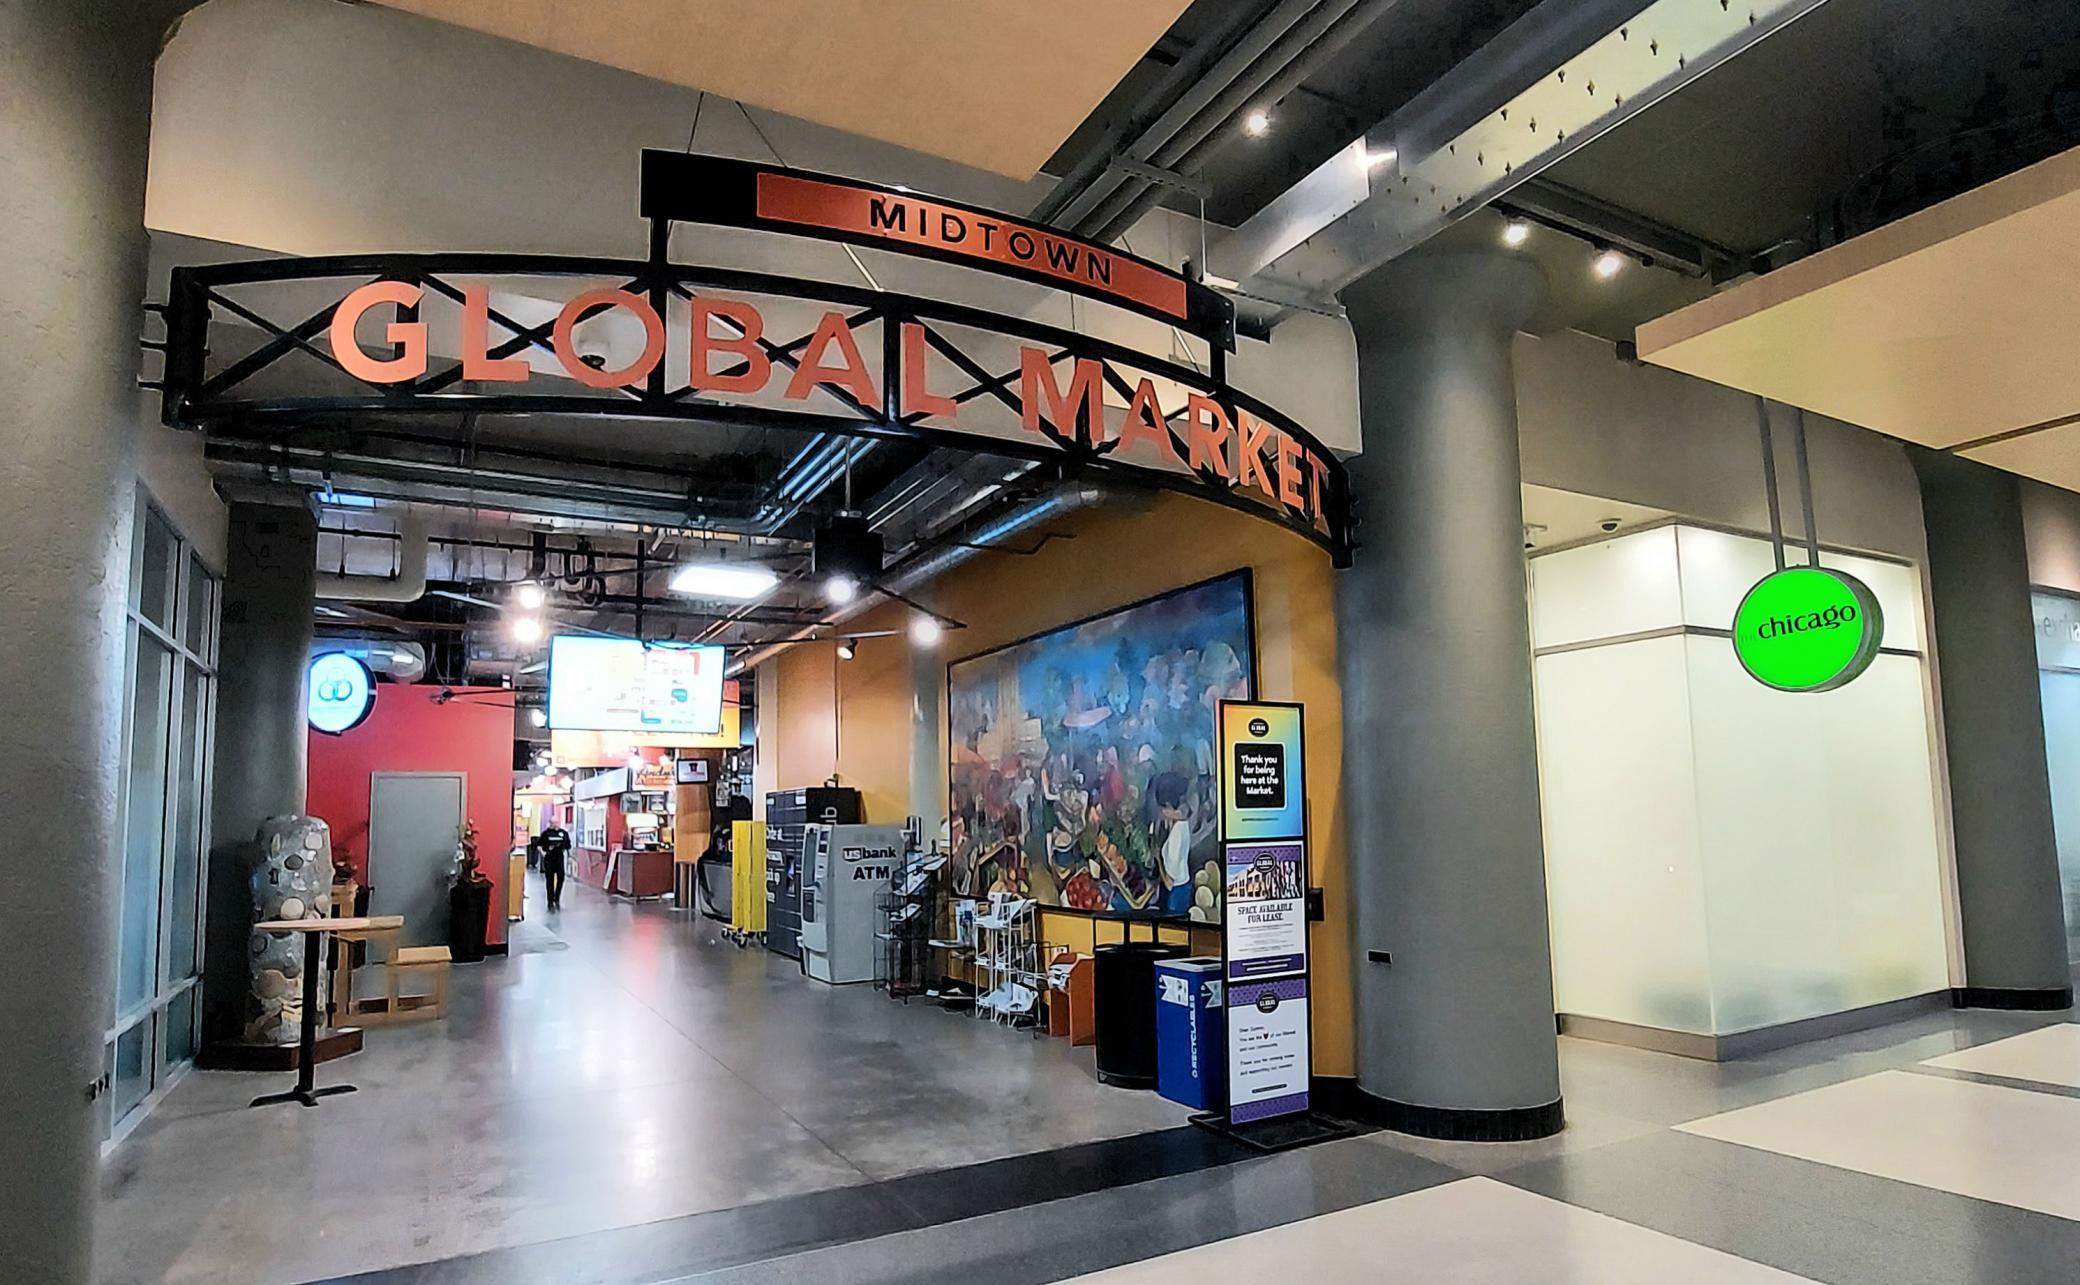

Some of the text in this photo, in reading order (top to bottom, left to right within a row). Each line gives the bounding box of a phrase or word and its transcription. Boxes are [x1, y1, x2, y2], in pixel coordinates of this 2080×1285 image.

[869, 196, 1113, 286] MIDTOWN
[329, 279, 1331, 521] GLOBAL MARKET
[1757, 603, 1857, 640] chicago
[1240, 754, 1278, 768] Thank you
[1243, 765, 1276, 776] for being
[1240, 775, 1279, 784] here at the
[854, 866, 889, 880] ATM
[1238, 903, 1293, 915] SPACE AVAILABLE
[1248, 912, 1283, 923] FOR LEASE
